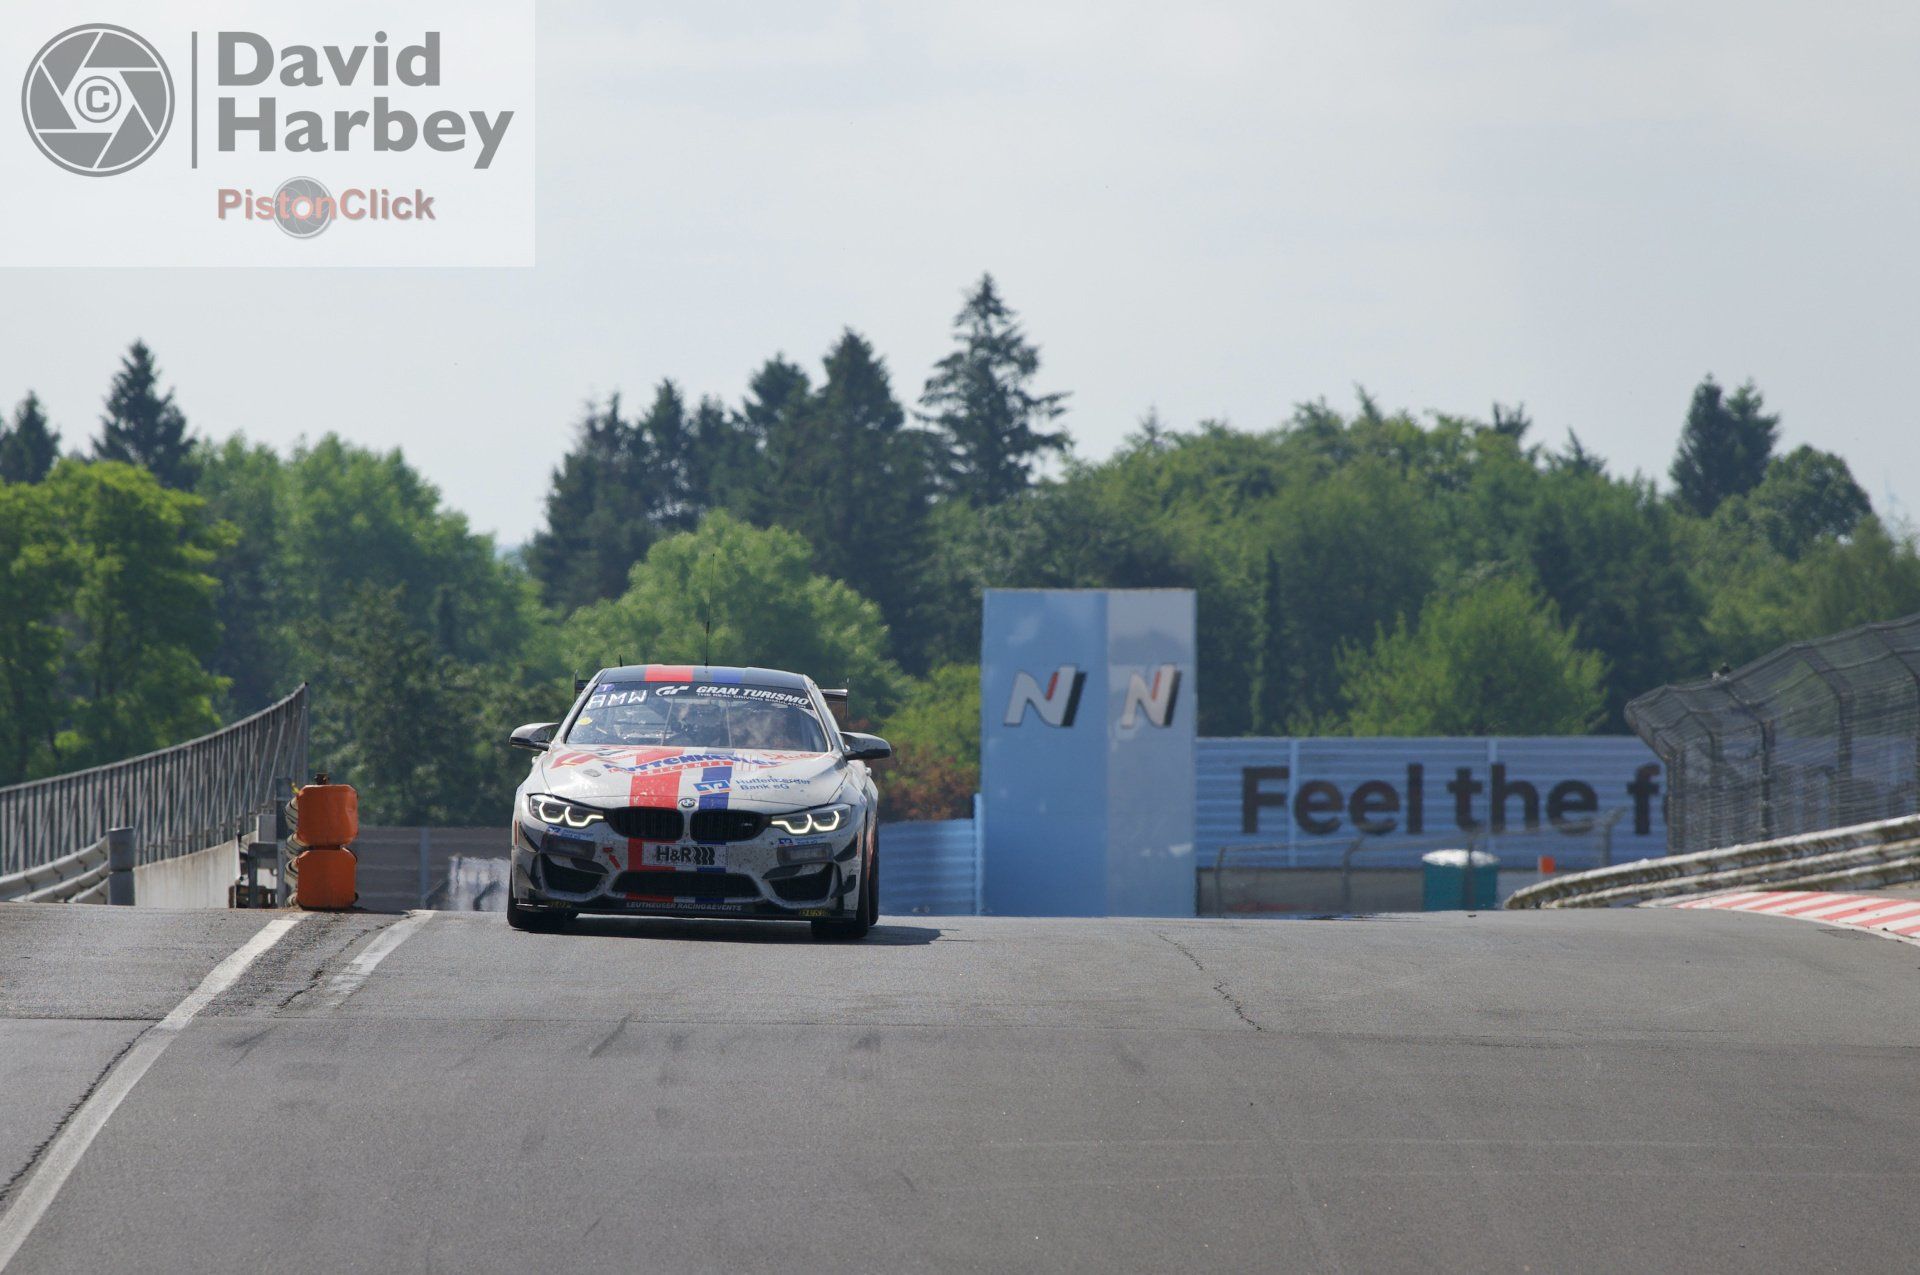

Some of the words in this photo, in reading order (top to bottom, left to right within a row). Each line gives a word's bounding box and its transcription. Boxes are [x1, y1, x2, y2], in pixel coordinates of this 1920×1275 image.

[696, 685, 740, 695] GRAN
[742, 688, 810, 706] TURISMO
[1242, 763, 1424, 836] Feel
[1446, 763, 1599, 835] the
[656, 845, 692, 863] H&R
